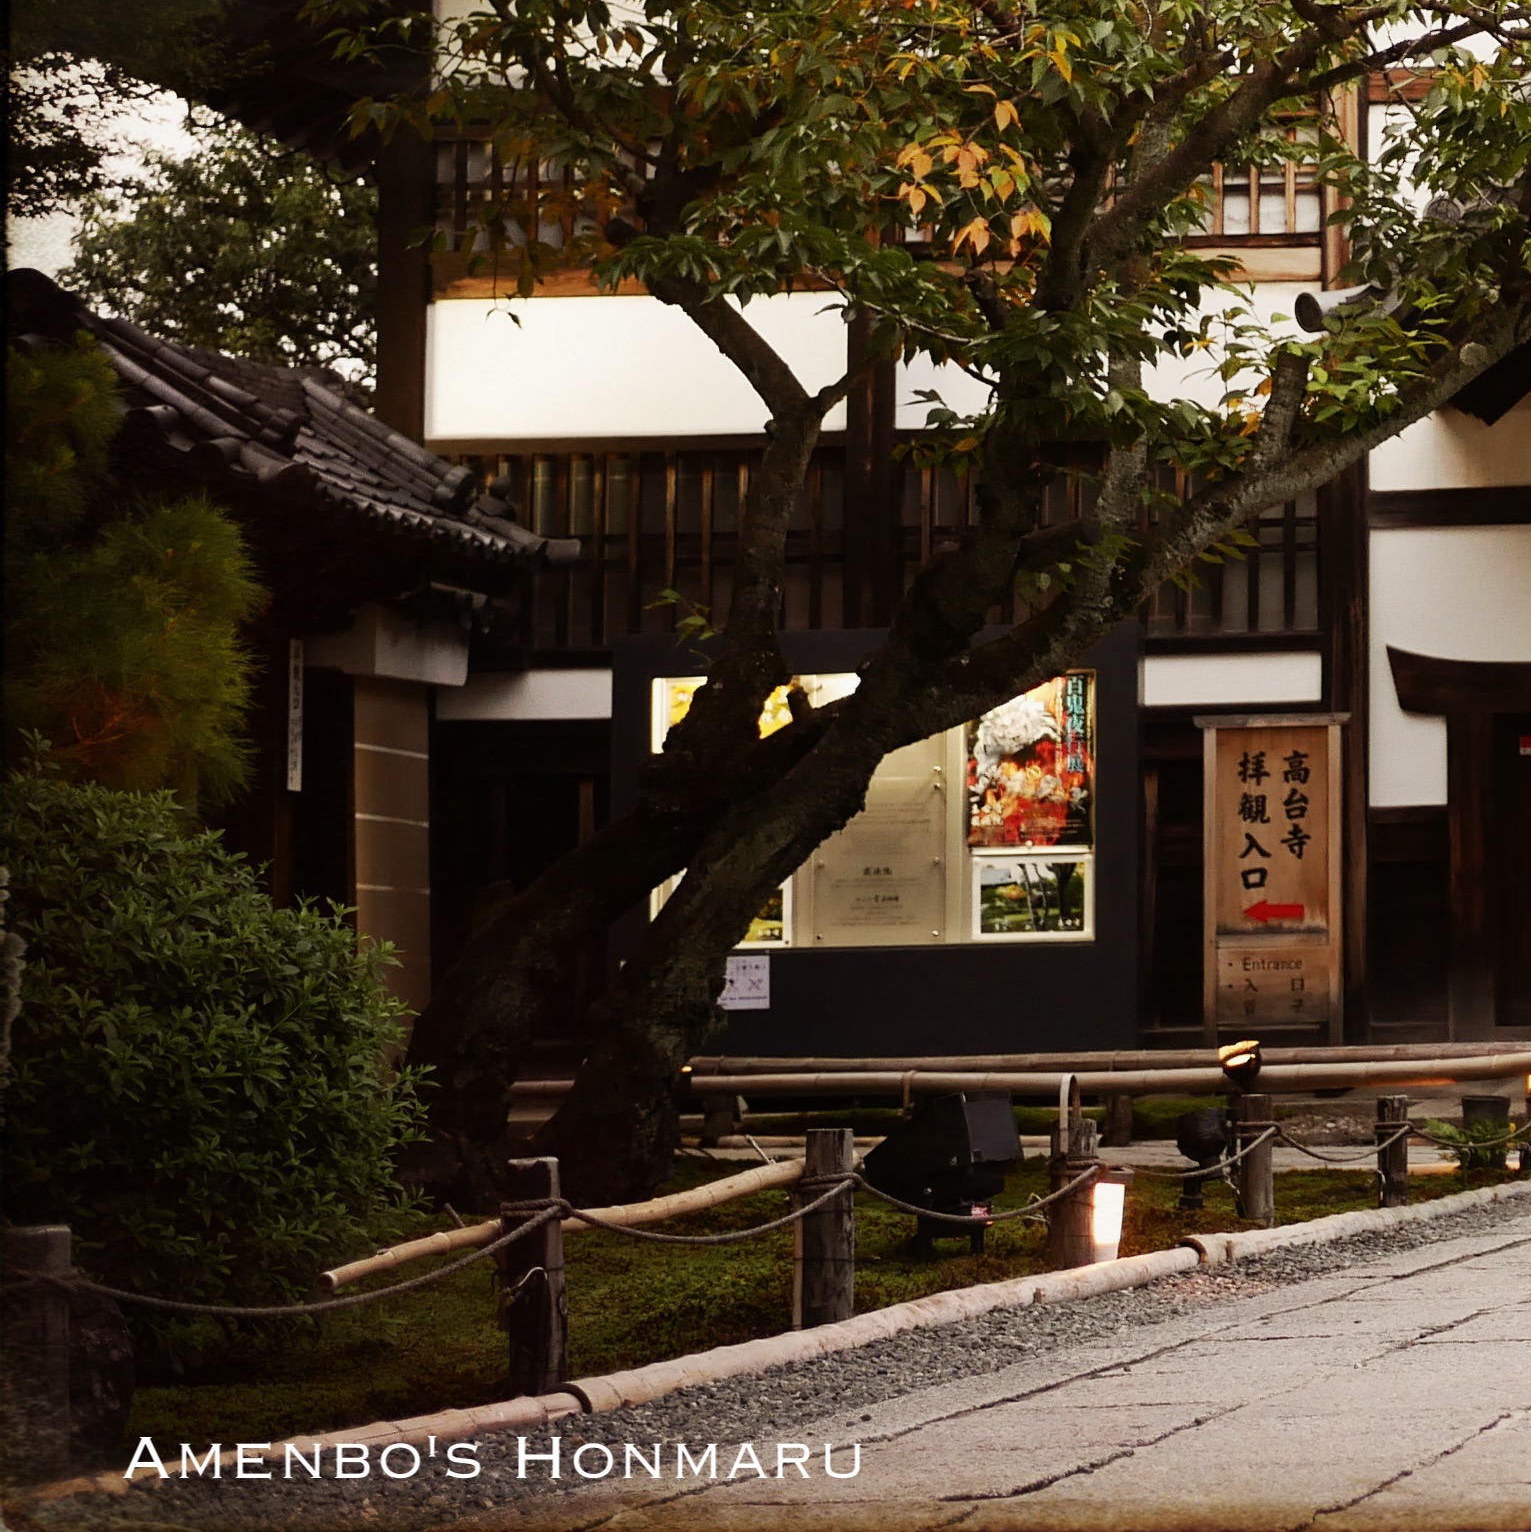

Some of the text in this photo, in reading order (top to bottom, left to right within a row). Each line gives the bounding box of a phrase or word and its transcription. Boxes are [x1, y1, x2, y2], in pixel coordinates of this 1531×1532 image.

[1237, 750, 1272, 890] 拝観入口
[1280, 749, 1312, 859] 高台寺
[1243, 956, 1303, 971] Entrance
